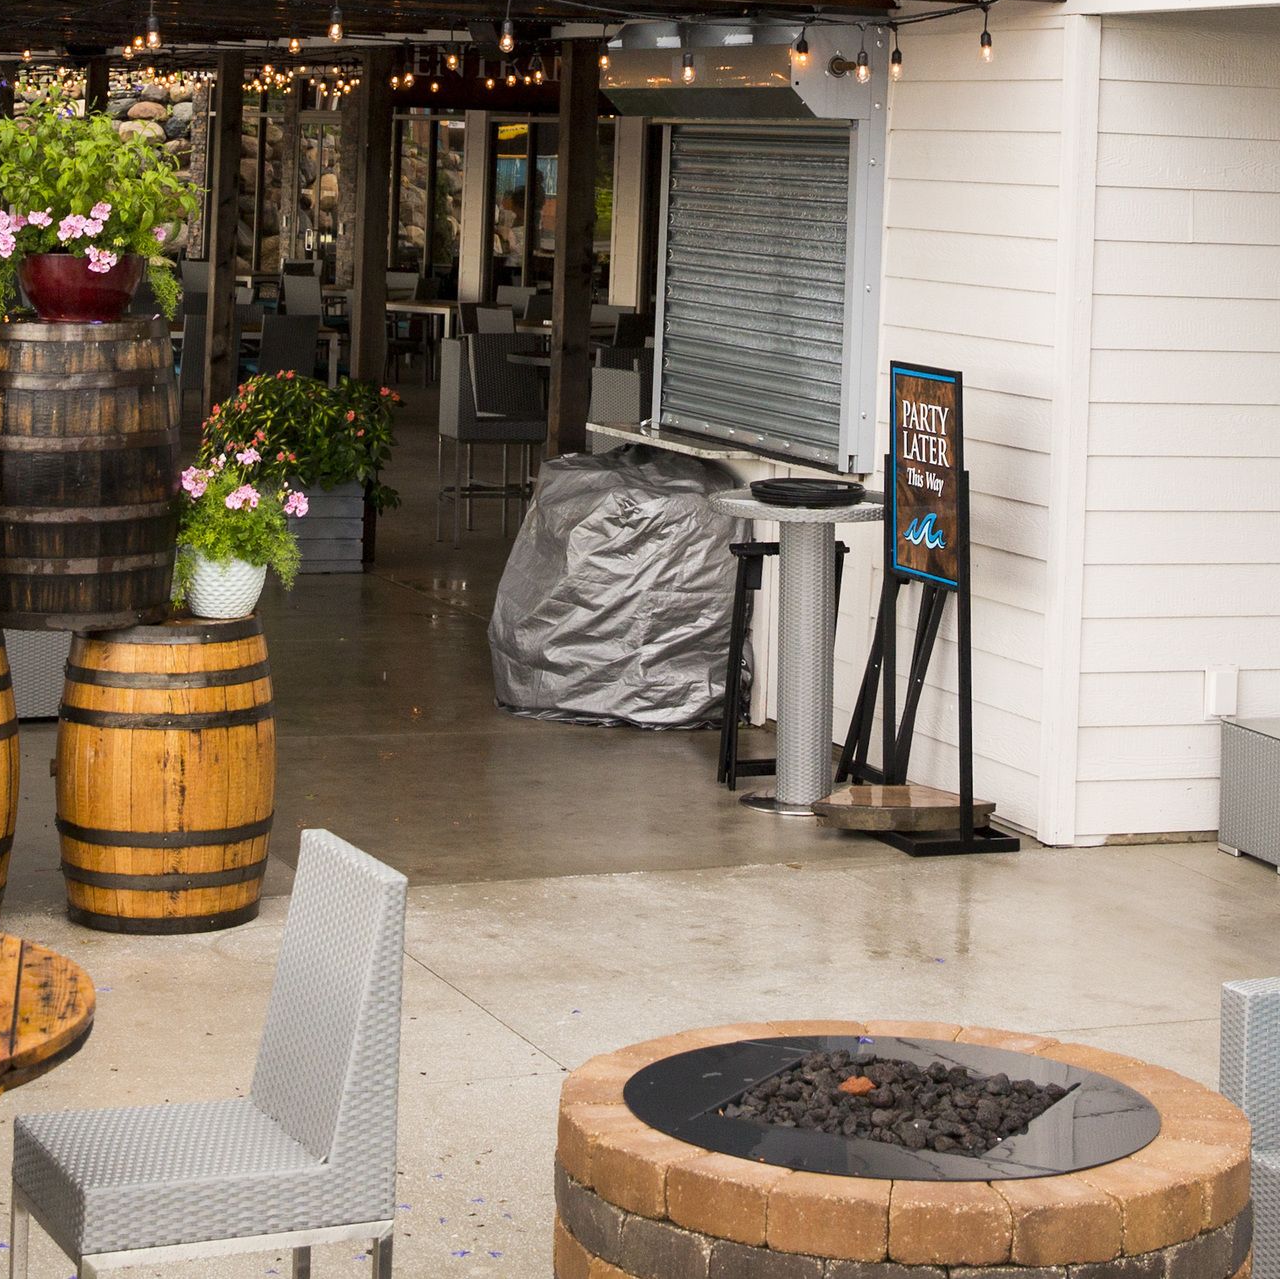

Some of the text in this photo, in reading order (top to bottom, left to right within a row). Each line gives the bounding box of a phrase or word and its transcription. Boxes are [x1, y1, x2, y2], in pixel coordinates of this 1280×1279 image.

[901, 399, 950, 436] PARTY
[902, 430, 950, 468] LATER
[906, 467, 945, 498] This Way
